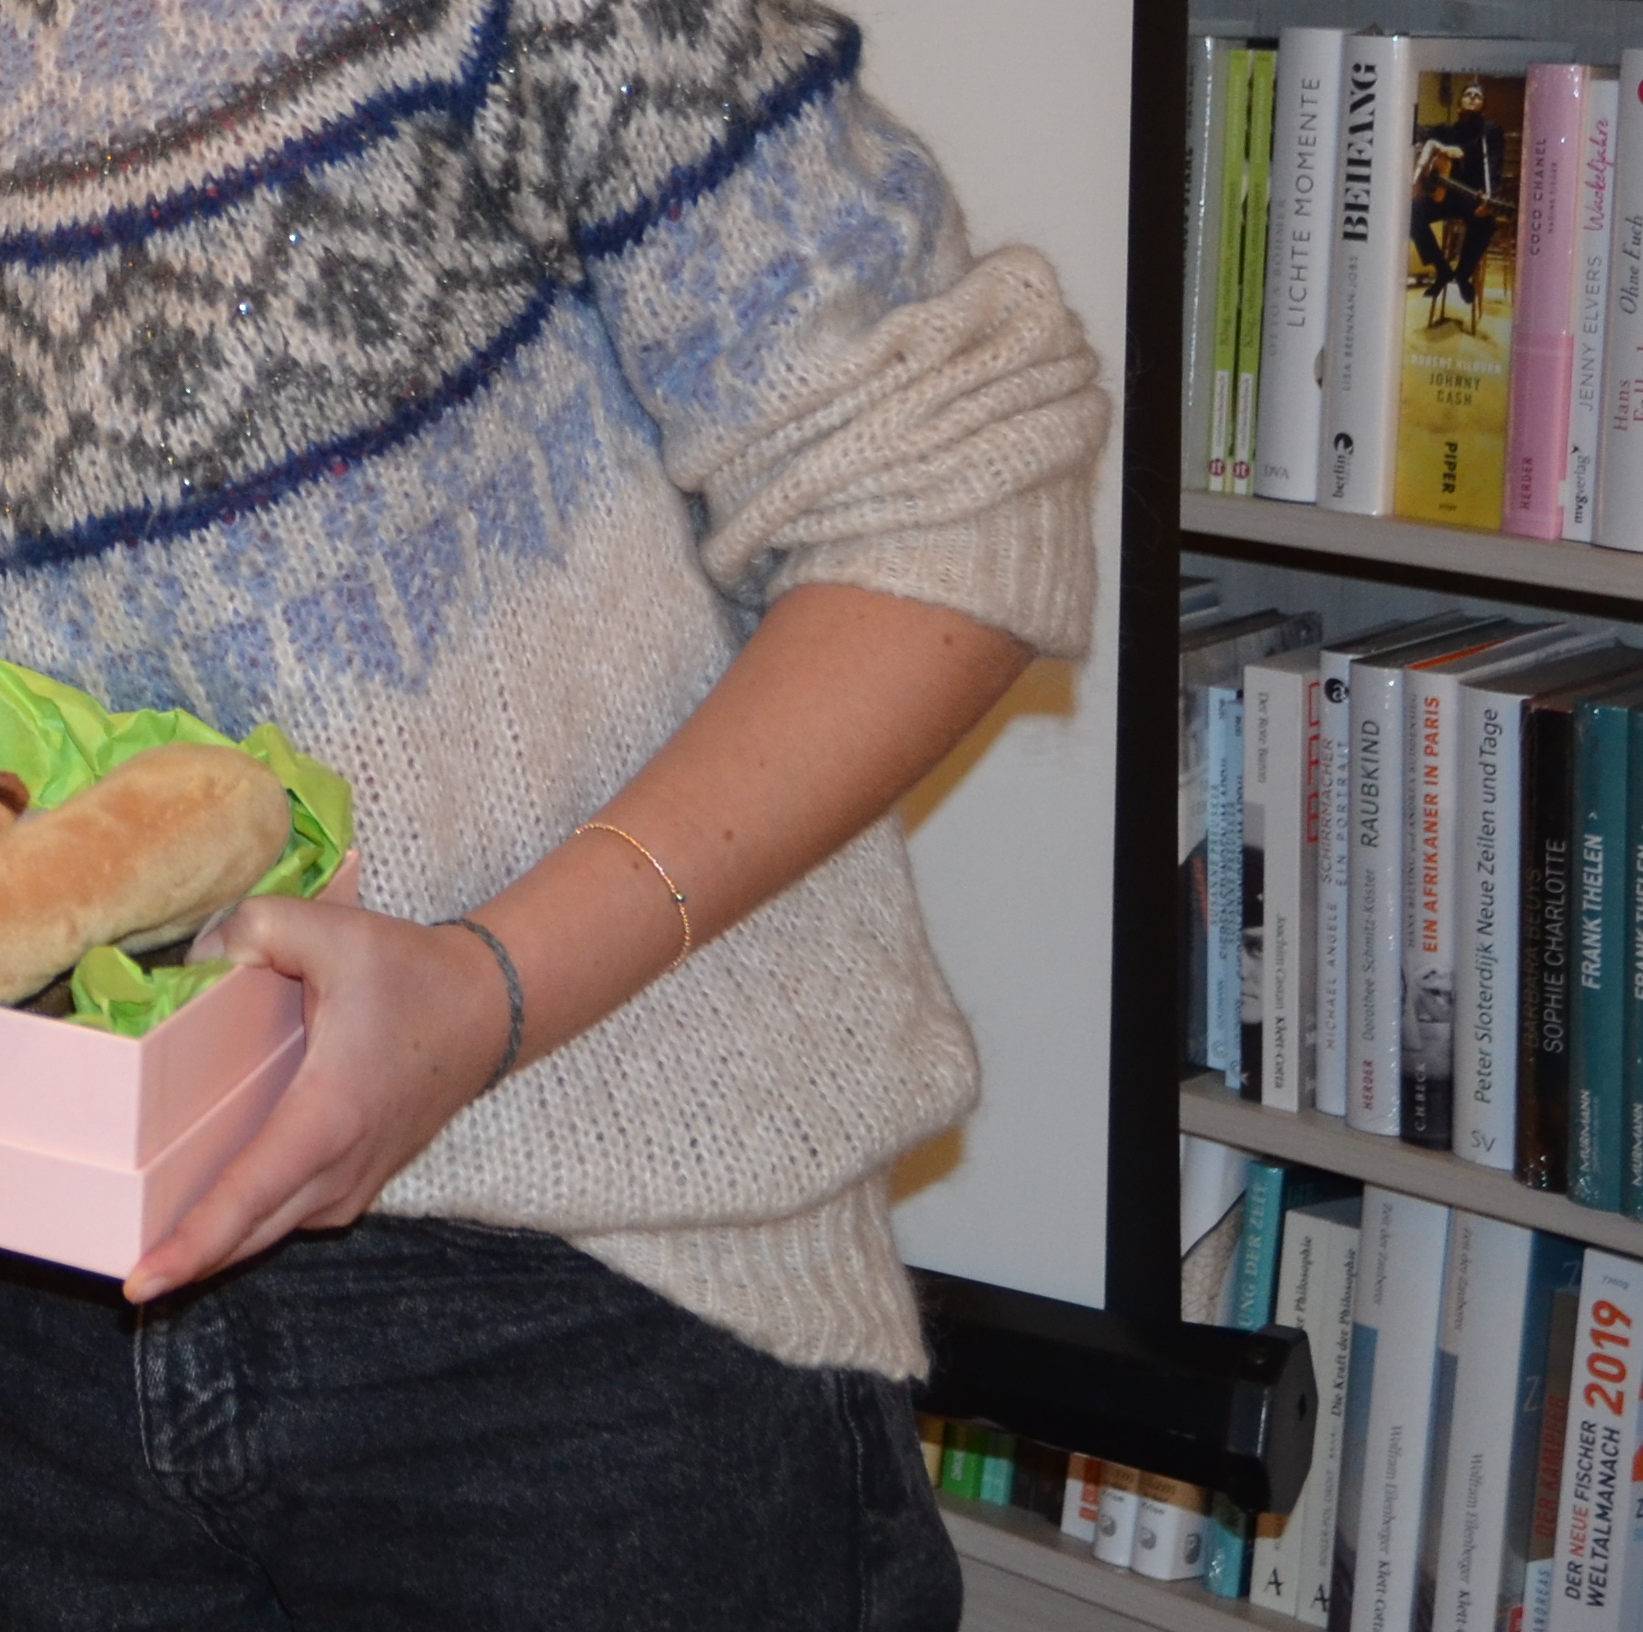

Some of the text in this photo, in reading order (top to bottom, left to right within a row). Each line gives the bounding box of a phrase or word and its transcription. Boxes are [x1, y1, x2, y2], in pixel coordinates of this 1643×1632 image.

[1341, 62, 1378, 244] BEIFANG
[1582, 116, 1616, 233] Wackeljahre
[1287, 77, 1320, 328] LICHTE MOMENTE
[1528, 137, 1547, 256] COCO CHANEL
[1621, 213, 1643, 260] Euch
[1618, 266, 1641, 315] Ohne
[1578, 254, 1603, 412] JENNY ELVERS
[1341, 363, 1353, 391] LISA
[1429, 373, 1481, 391] JOHNNY
[1437, 390, 1472, 406] CASH
[1613, 378, 1631, 432] Hans
[1331, 454, 1347, 498] berlin
[1442, 441, 1458, 494] PIPER
[1520, 457, 1533, 510] HERDER
[1257, 691, 1269, 713] Der
[1319, 738, 1334, 884] SCHIRRMACHER
[1336, 740, 1349, 888] EIN PORTRAIT
[1360, 720, 1381, 848] RAUBKIND
[1423, 696, 1440, 953] EIN AFRIKANER IN PARIS
[1274, 913, 1287, 966] Joachim
[1474, 708, 1499, 1104] Peter Sloterdijk Neue Zeilen und Tage
[1542, 837, 1567, 1054] SOPHIE CHARLOTTE
[1581, 833, 1604, 990] FRANK THELEN
[1324, 900, 1338, 1051] MICHAEL ANGELE
[1361, 979, 1376, 1041] Dorothee
[1522, 946, 1540, 1049] BARBARA
[1274, 1016, 1286, 1090] Klett-Cotta
[1362, 1059, 1374, 1111] HERDER
[1579, 1089, 1592, 1172] MURMANN
[1631, 1102, 1643, 1187] MURMANN
[1244, 1183, 1267, 1276] DER ZEIT
[1377, 1228, 1391, 1250] der
[1380, 1202, 1394, 1226] Zeit
[1294, 1235, 1313, 1312] Philosophie
[1459, 1253, 1471, 1275] der
[1330, 1247, 1357, 1417] Die Kraft der Philosophie
[1583, 1299, 1632, 1416] 2019
[1384, 1425, 1404, 1480] Wolfram
[1377, 1483, 1400, 1555] Eilenberger
[1459, 1452, 1484, 1585] Wolfram Eilenberger
[1535, 1496, 1557, 1538] DER
[1564, 1420, 1597, 1601] DER NEUE FISCHER
[1586, 1426, 1621, 1609] WELTALMANACH
